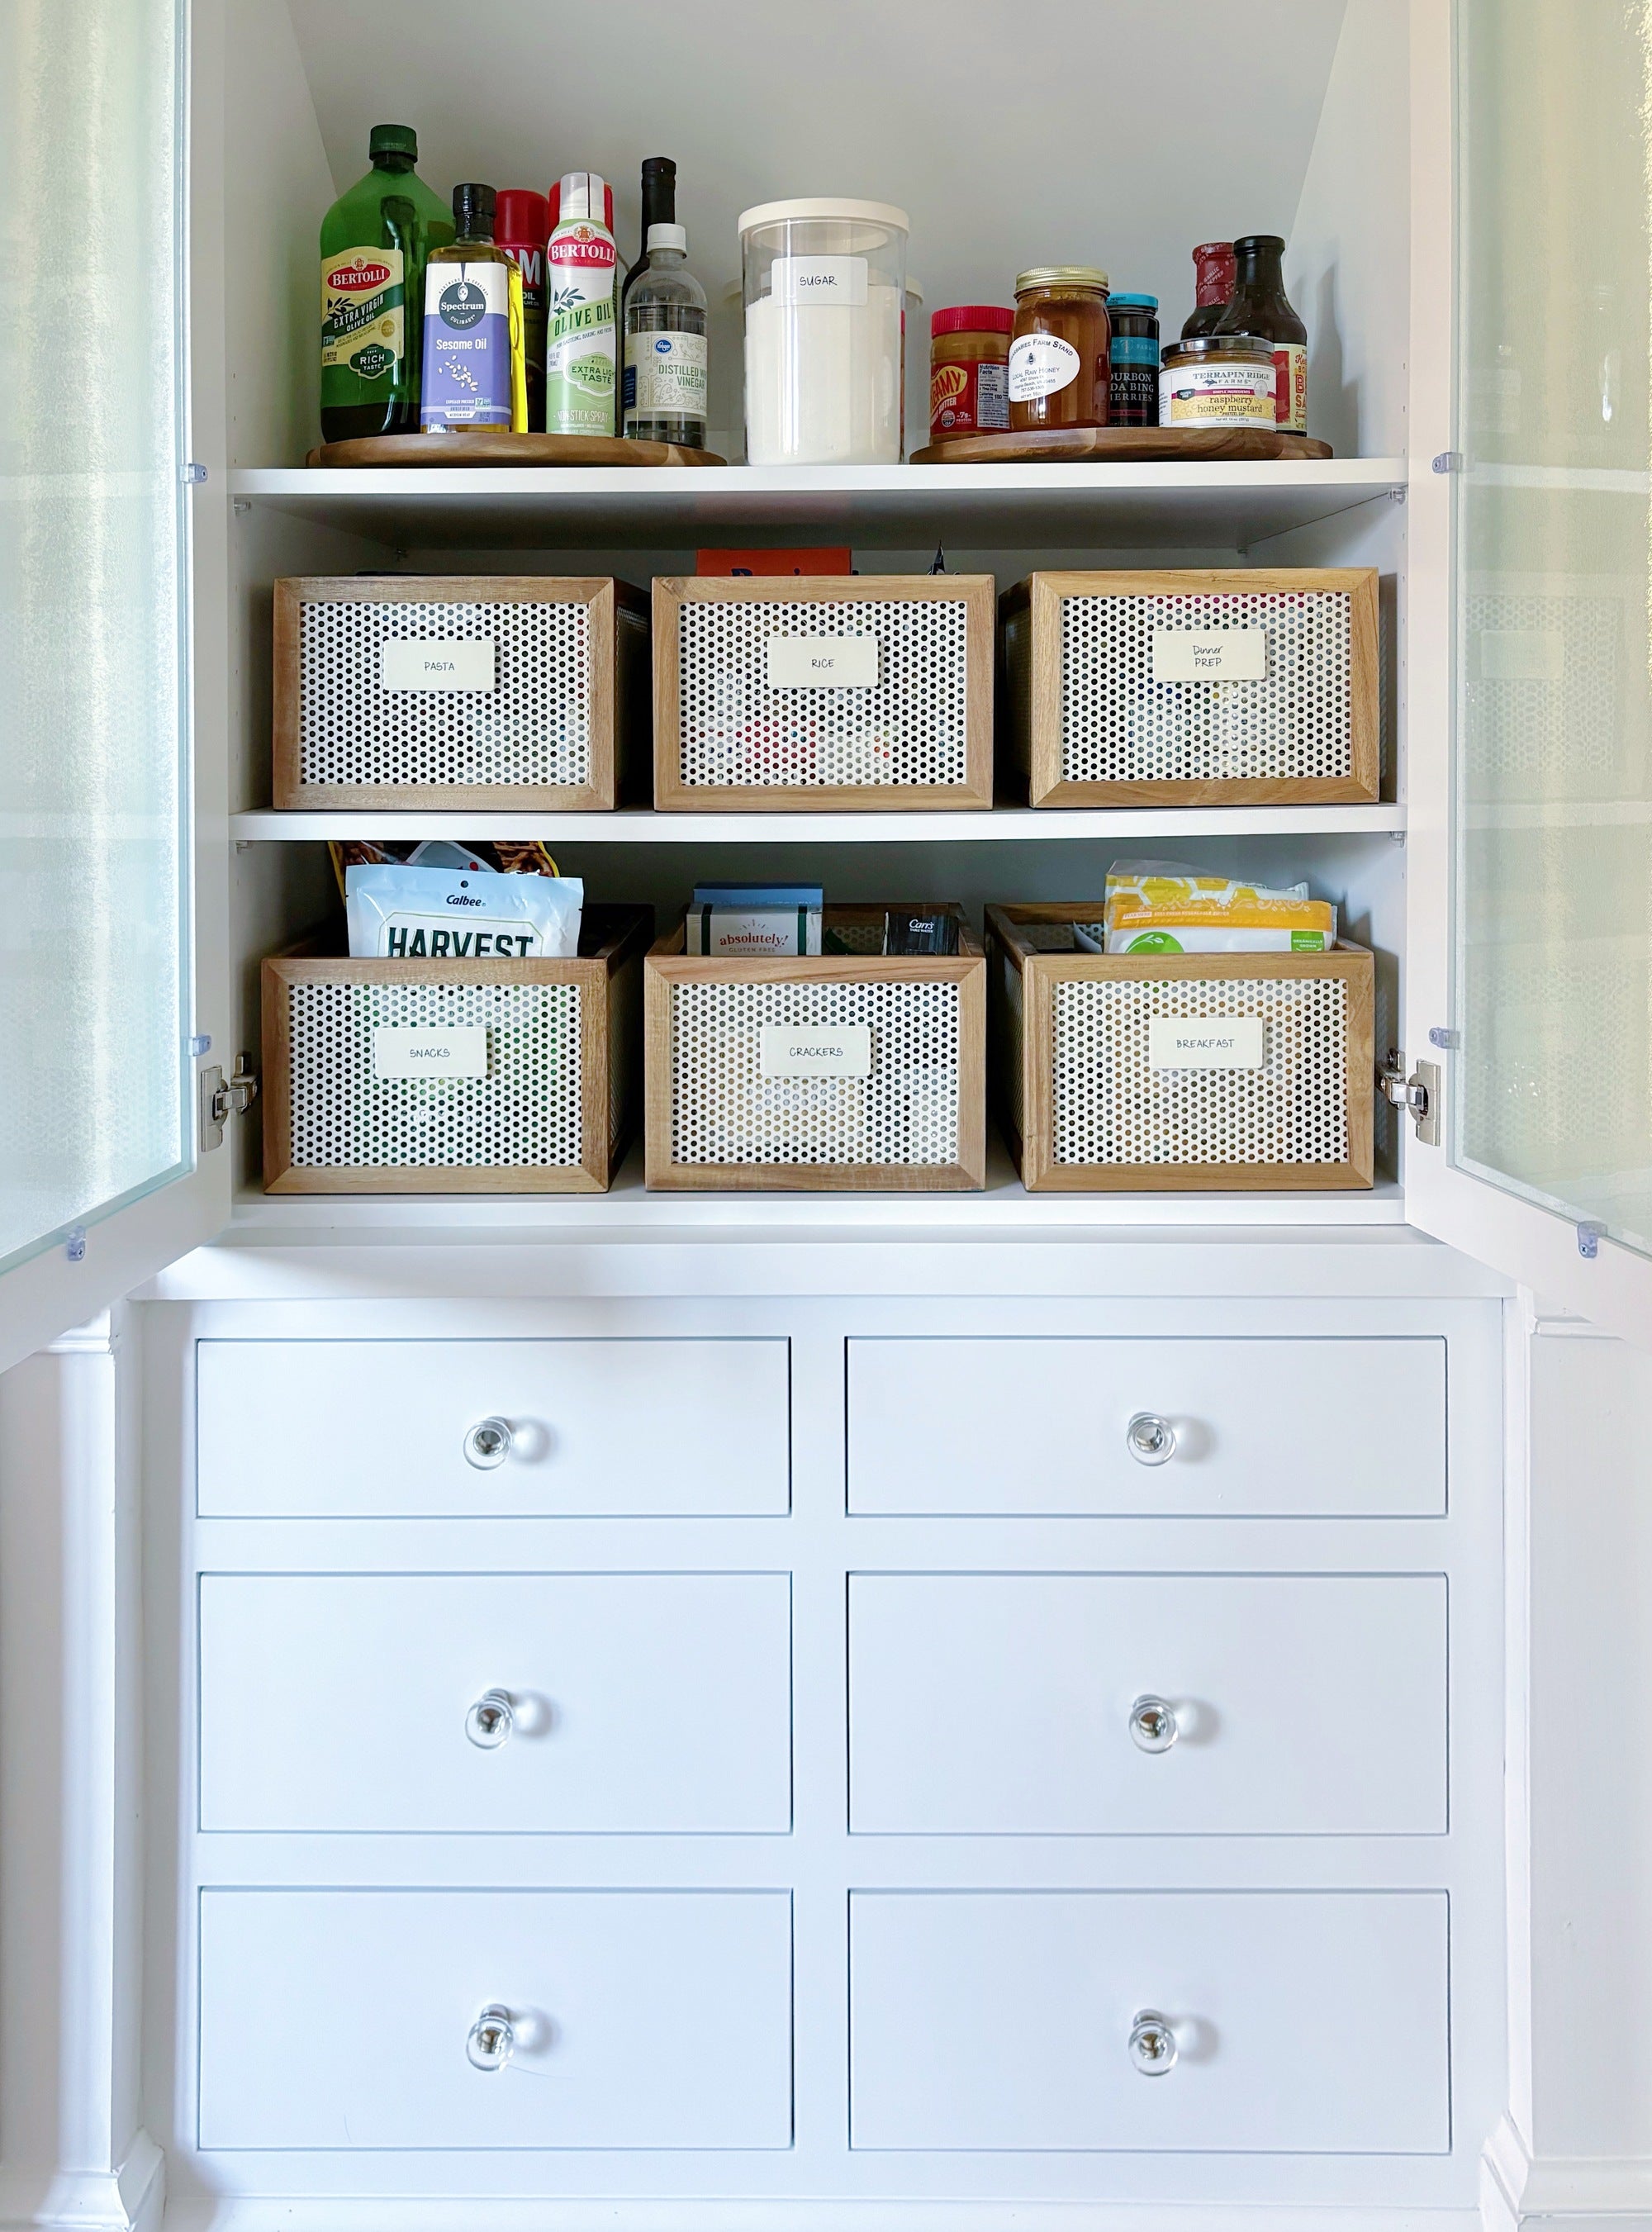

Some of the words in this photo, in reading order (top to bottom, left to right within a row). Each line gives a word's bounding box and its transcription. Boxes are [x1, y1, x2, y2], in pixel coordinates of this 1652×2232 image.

[551, 245, 615, 263] BERTOLLI
[333, 268, 385, 287] BERTOLLI
[800, 276, 838, 286] SUGAR
[334, 308, 359, 329] EXTRA
[361, 293, 384, 316] VIRGIN
[441, 302, 484, 312] Spectrum
[346, 318, 364, 332] OLIVE
[365, 313, 375, 322] OIL
[450, 316, 474, 325] CULINARY
[555, 308, 591, 336] OLIVE
[596, 303, 611, 321] OIL
[436, 339, 472, 350] Sesame
[475, 338, 487, 349] Oil
[359, 354, 385, 364] RICH
[572, 366, 601, 375] EXTRA
[658, 364, 699, 378] DISTILLED
[1193, 371, 1245, 380] TERRAPIN
[1246, 372, 1270, 380] RIDGE
[582, 373, 611, 384] TASTE
[677, 376, 705, 390] VINEGAR
[1130, 383, 1154, 392] BING
[1209, 394, 1253, 405] raspberry
[1197, 403, 1226, 413] honey
[1228, 404, 1263, 413] mustard
[590, 411, 609, 423] SPRAY
[1193, 644, 1223, 655] Dinner
[425, 662, 455, 671] PASTA
[811, 658, 835, 668] RICE
[1194, 658, 1222, 667] PREP
[446, 895, 482, 907] Calbee
[909, 919, 934, 929] Carr's
[389, 927, 534, 957] HARVEST
[719, 933, 789, 947] absolutely!
[1176, 1039, 1235, 1048] BREAKFAST
[410, 1048, 450, 1057] SNACKS
[790, 1047, 843, 1057] CRACKERS
